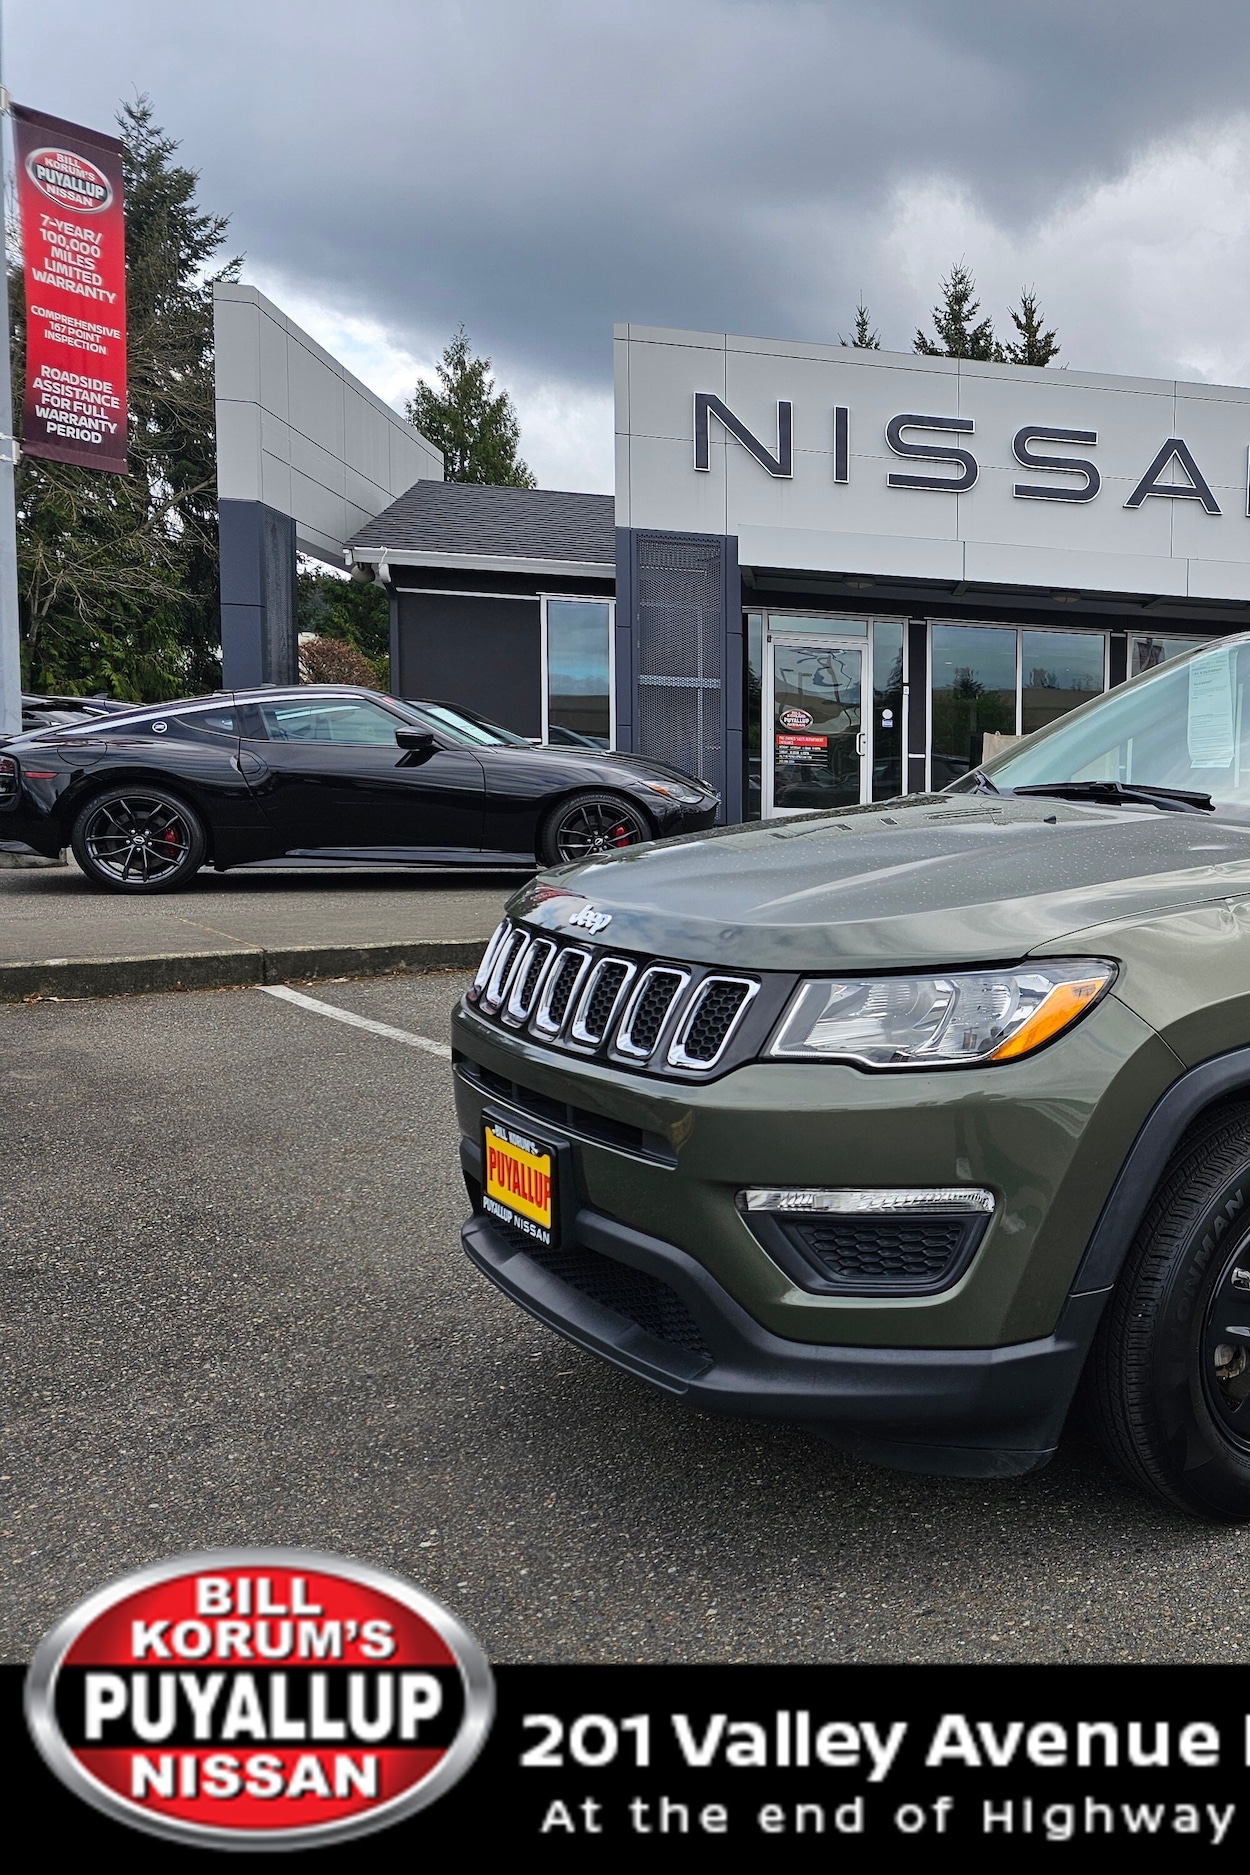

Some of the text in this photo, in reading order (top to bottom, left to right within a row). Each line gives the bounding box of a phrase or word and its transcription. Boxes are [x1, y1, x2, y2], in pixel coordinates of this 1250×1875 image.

[44, 158, 95, 181] KORUM'S
[57, 153, 81, 168] BILL
[36, 165, 106, 200] PUYALLUP
[46, 184, 93, 207] NISSAN
[39, 213, 102, 245] 7-YEAR/
[39, 228, 101, 258] 100,000
[44, 257, 103, 286] LIMITED
[50, 246, 96, 271] MILES
[31, 267, 117, 304] WARRANTY
[30, 304, 121, 339] COMPREHENSIVE
[49, 320, 101, 343] 167 POINT
[44, 329, 107, 355] INSPECTION
[32, 377, 120, 409] ASSISTANCE
[41, 364, 113, 394] ROADSIDE
[35, 405, 118, 434] WARRANTY
[41, 392, 109, 419] FOR FULL
[46, 421, 102, 444] PERIOD
[568, 904, 612, 936] Jeep
[494, 1124, 508, 1141] BILL
[488, 1146, 551, 1212] PUYALLUP
[483, 1195, 551, 1245] PUYALLUP NISSAN
[1169, 1187, 1245, 1364] ONMAN
